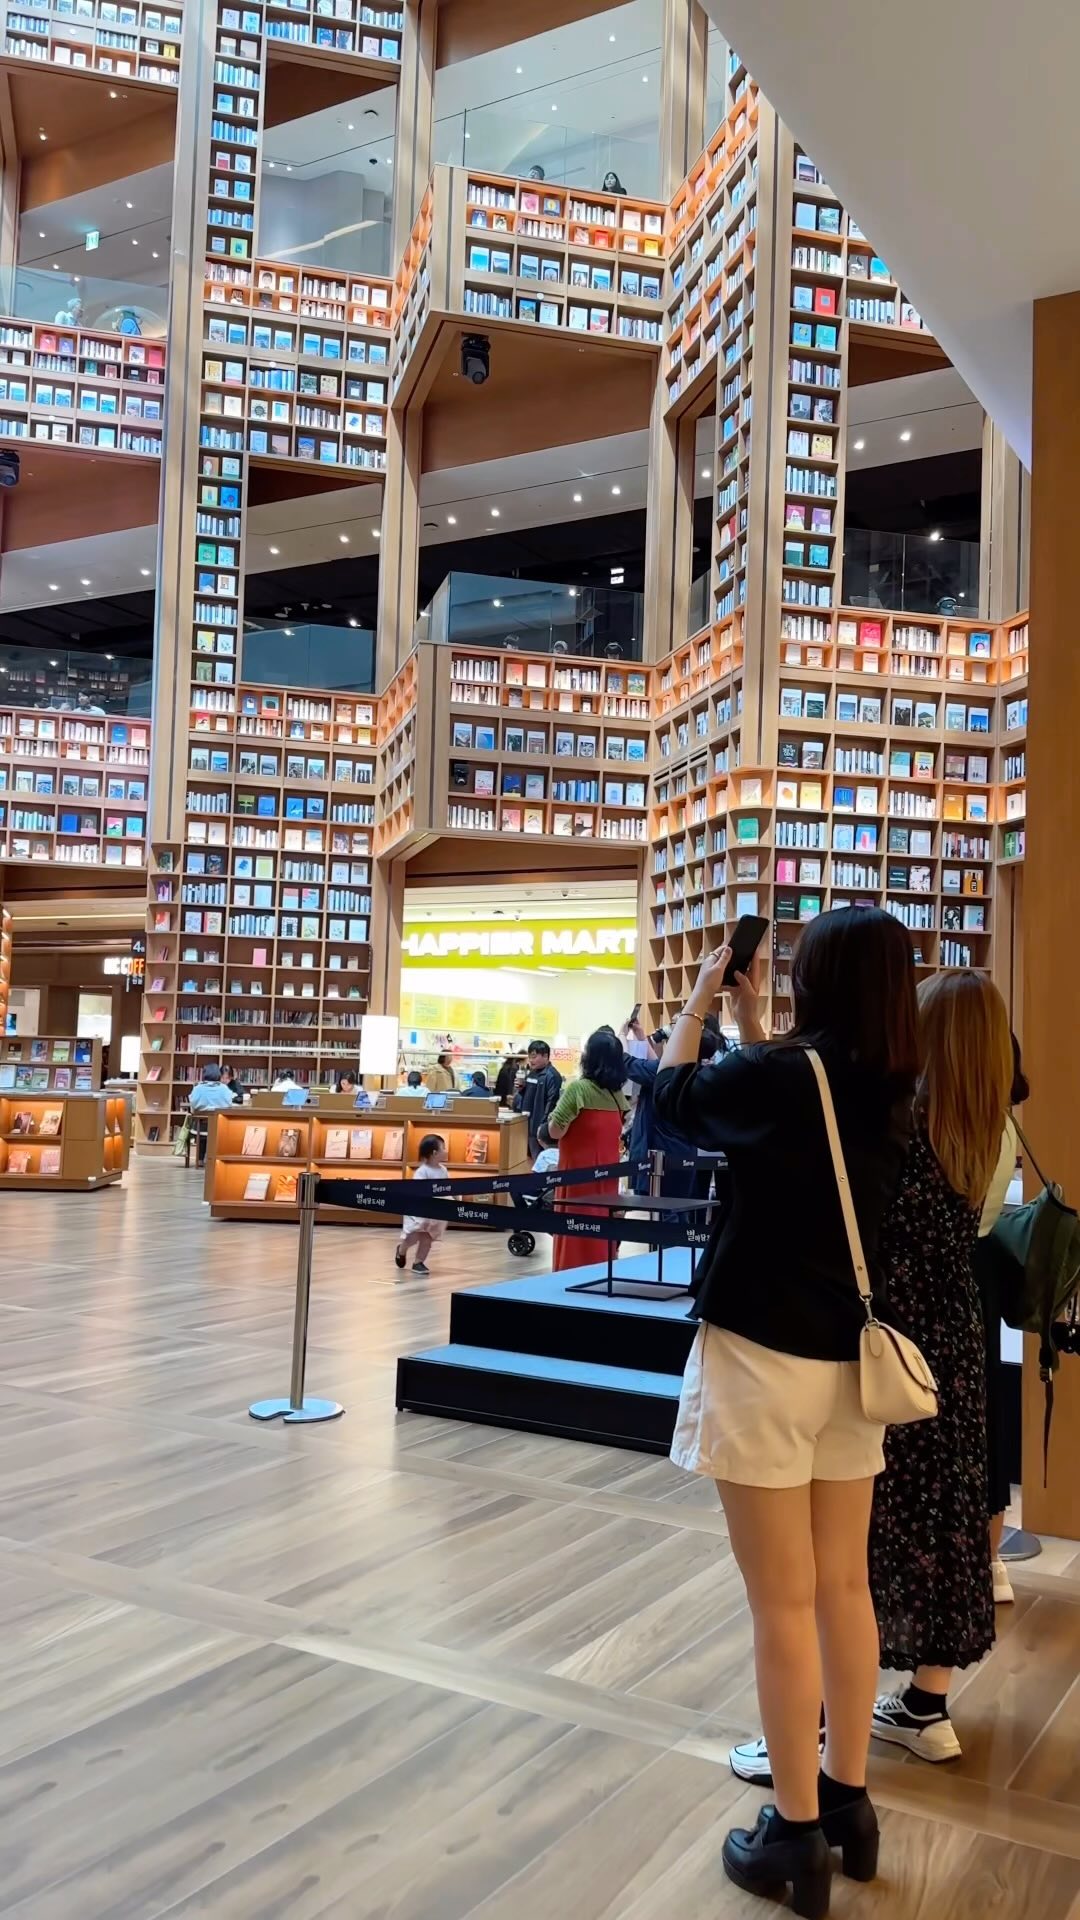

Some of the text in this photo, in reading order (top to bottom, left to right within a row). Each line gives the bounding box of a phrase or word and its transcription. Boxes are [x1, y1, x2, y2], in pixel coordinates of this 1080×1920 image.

[401, 929, 637, 956] HAPPIER MART
[566, 1219, 600, 1232] 별마당도서관
